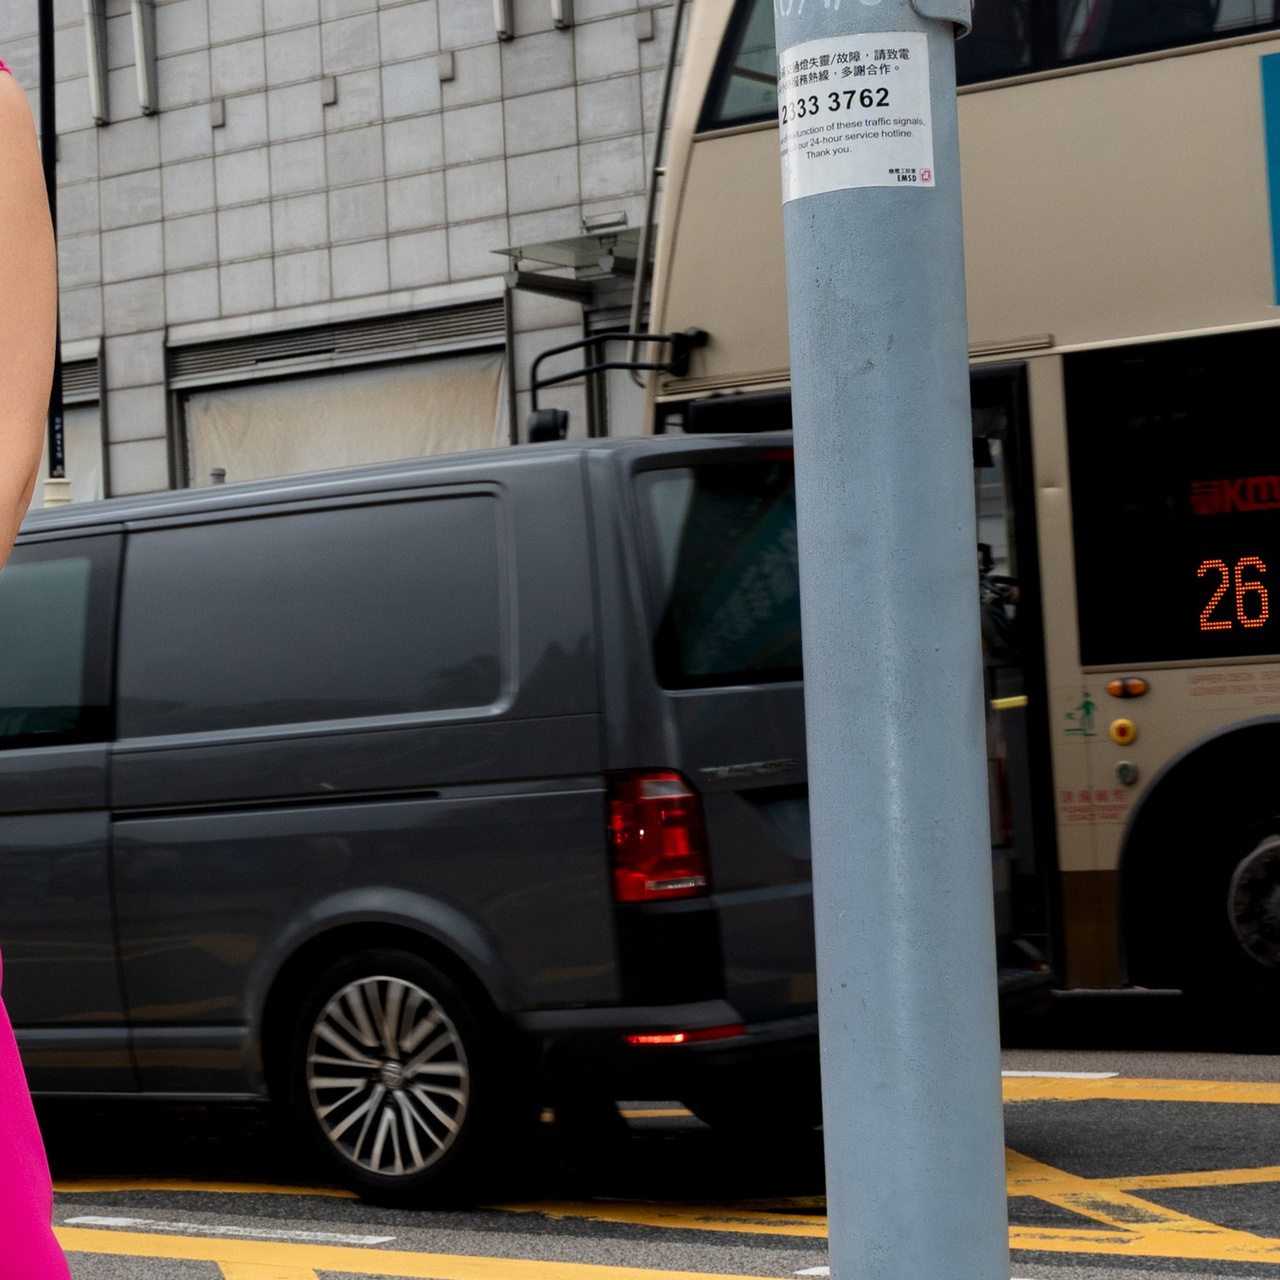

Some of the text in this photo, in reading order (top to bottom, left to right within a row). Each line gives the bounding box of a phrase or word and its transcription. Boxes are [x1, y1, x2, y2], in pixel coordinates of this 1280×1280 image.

[828, 87, 890, 112] 3762
[826, 122, 835, 132] of
[836, 120, 863, 129] these
[865, 117, 892, 126] traffic
[893, 117, 926, 127] signals,
[798, 129, 914, 150] our 24-hour service hotline.
[806, 147, 852, 159] Thank you.
[897, 174, 917, 182] EMSD
[1197, 556, 1269, 631] 26
